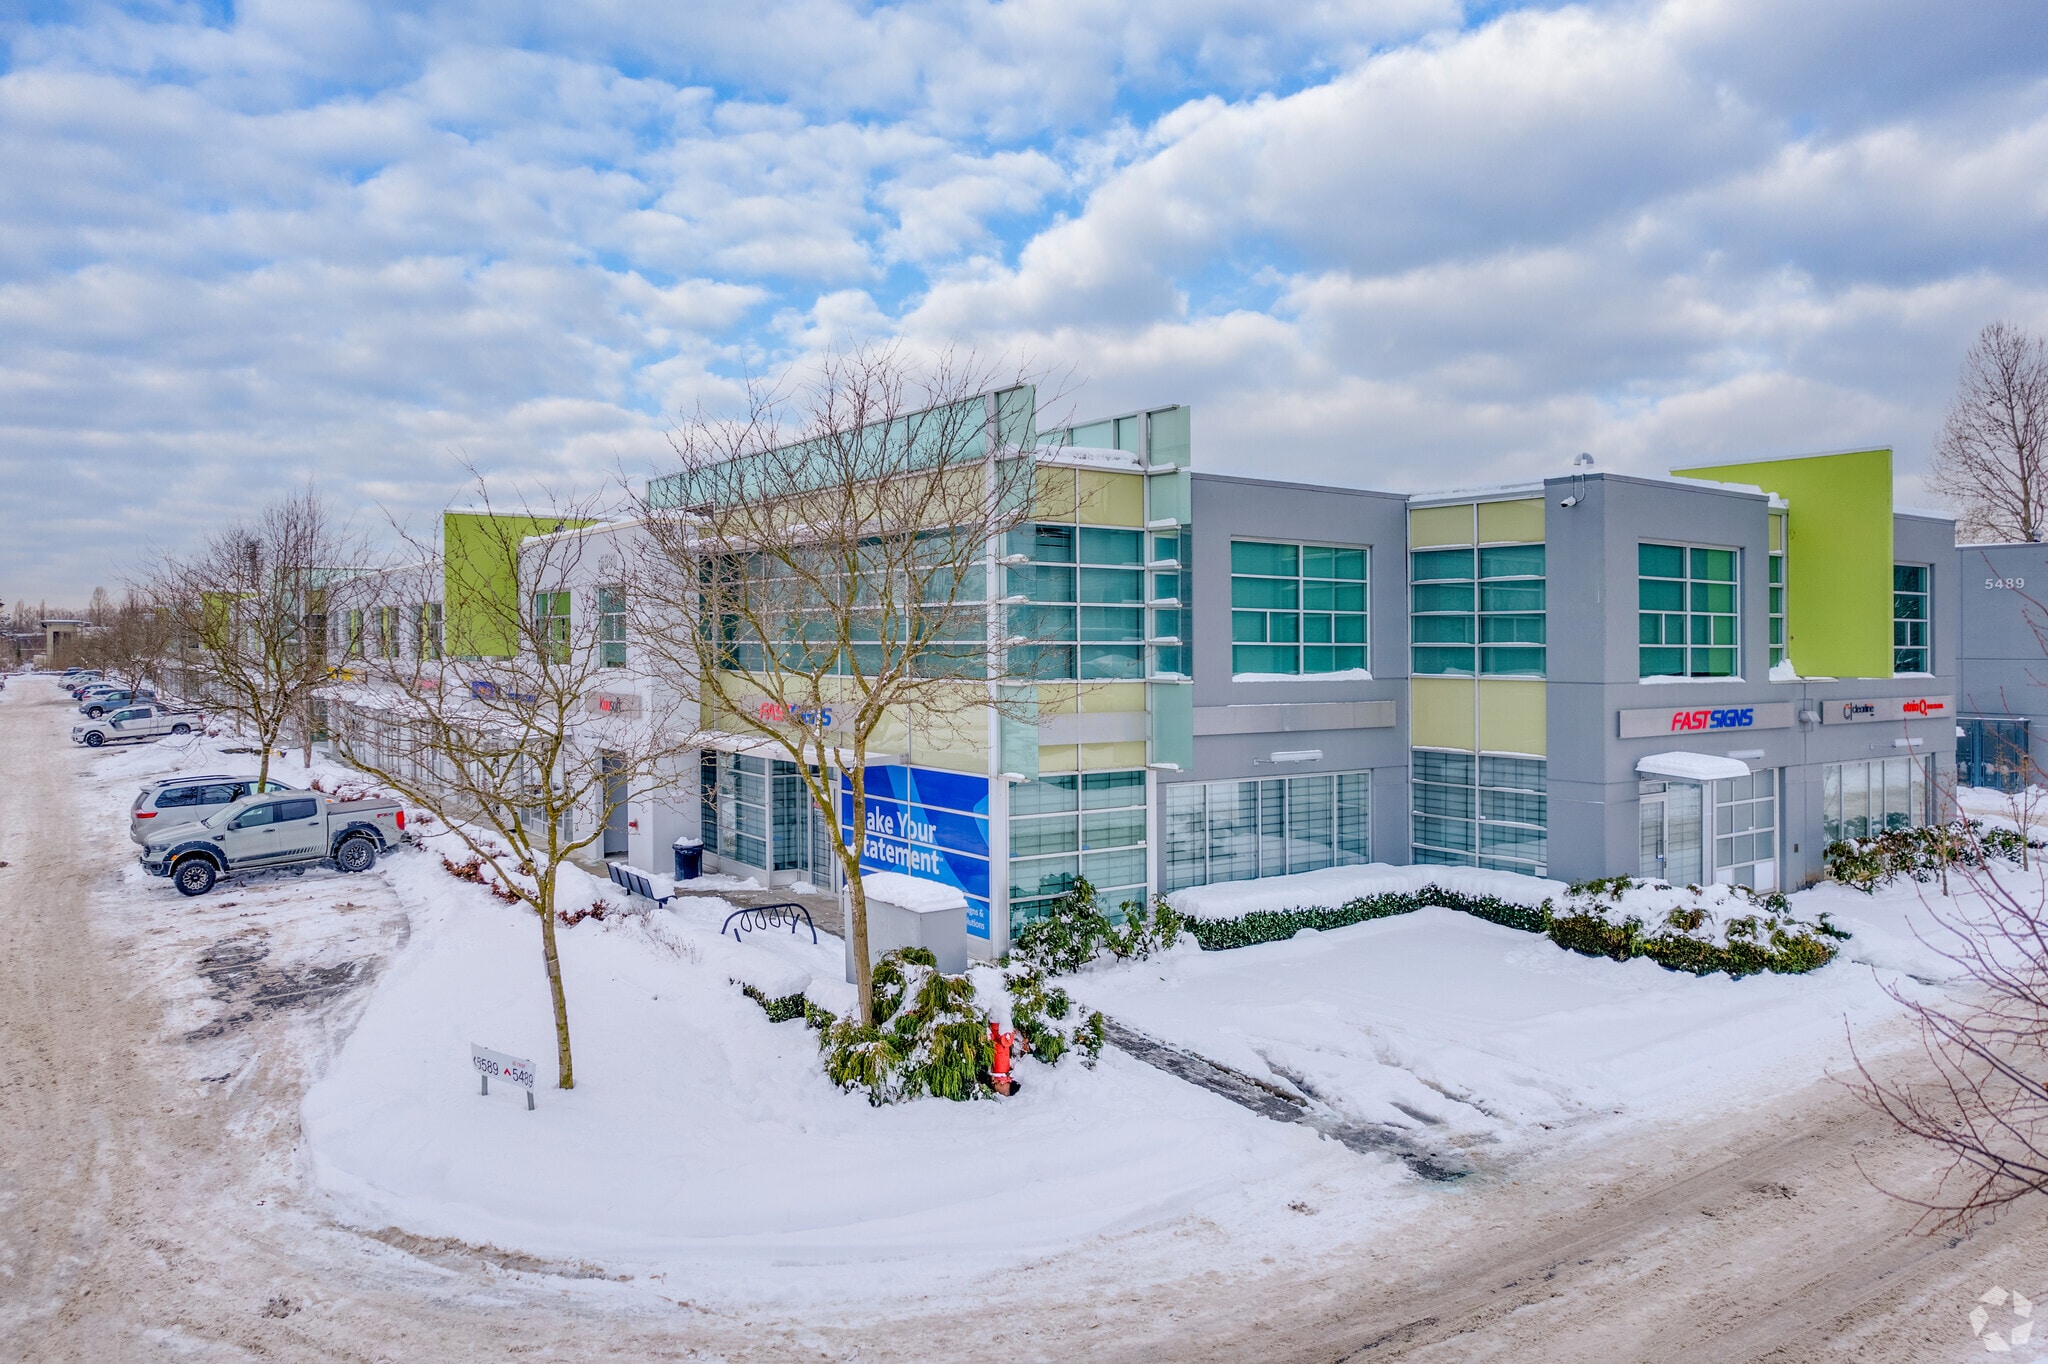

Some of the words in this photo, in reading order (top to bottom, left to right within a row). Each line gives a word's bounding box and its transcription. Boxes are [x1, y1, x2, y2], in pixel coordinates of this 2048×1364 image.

[1984, 577, 2026, 590] 5489
[1671, 708, 1754, 732] FASTSIGNS
[866, 805, 894, 836] ake
[896, 811, 937, 844] Your
[863, 834, 940, 876] tatement
